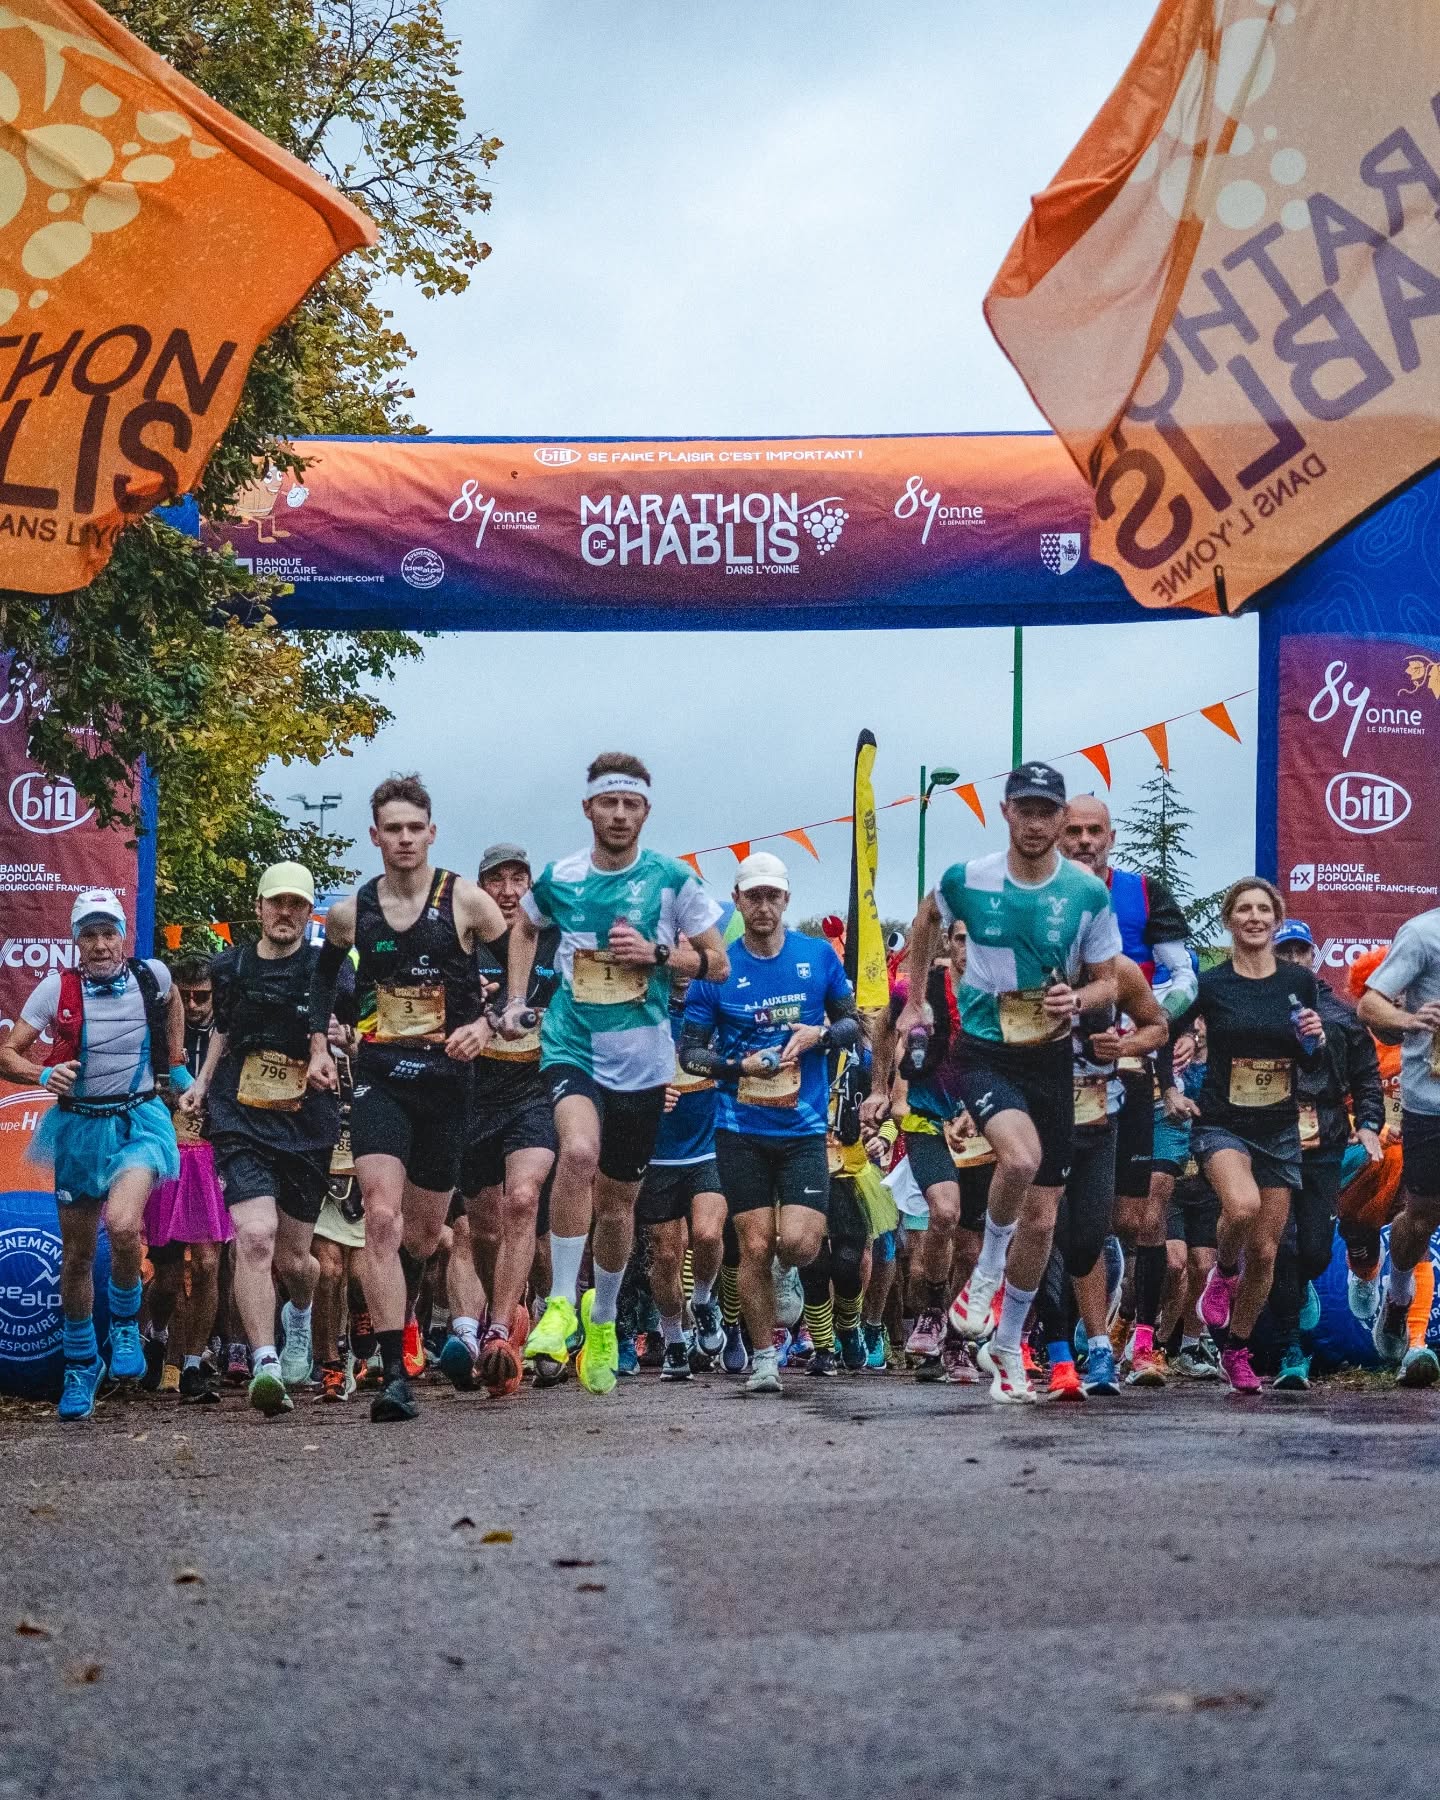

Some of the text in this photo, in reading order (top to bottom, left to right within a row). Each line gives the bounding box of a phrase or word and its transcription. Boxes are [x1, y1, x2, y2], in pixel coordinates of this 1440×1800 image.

[588, 452, 608, 463] SE
[612, 452, 654, 463] FAIRE
[659, 451, 714, 463] PLAISIR
[719, 451, 762, 462] C'EST
[766, 450, 855, 461] IMPORTANT
[580, 492, 798, 525] MARATHON
[581, 521, 800, 566] CHABLIS
[593, 540, 607, 549] DE
[256, 557, 302, 566] BANQUE
[256, 566, 318, 575] POPULAIRE
[726, 565, 800, 575] DANS L'YONNE
[313, 574, 385, 583] FRANCHE-COMTÉ
[1378, 725, 1426, 735] DÉPARTEMENT
[0, 863, 46, 873] BANQUE
[1317, 864, 1365, 872] BANQUE
[0, 873, 61, 882] POPULAIRE
[1317, 873, 1380, 883] POPULAIRE
[1317, 883, 1439, 895] BOURGOGNE FRANCHE-COMTÉ
[34, 969, 44, 978] by
[604, 967, 613, 980] 1
[762, 993, 807, 1007] AUXERRE
[404, 1001, 413, 1013] 3
[754, 1006, 799, 1023] LA TOUR
[260, 1064, 287, 1080] 796
[1255, 1073, 1272, 1086] 69
[0, 1121, 20, 1133] upe
[0, 1236, 63, 1265] ENEMEN
